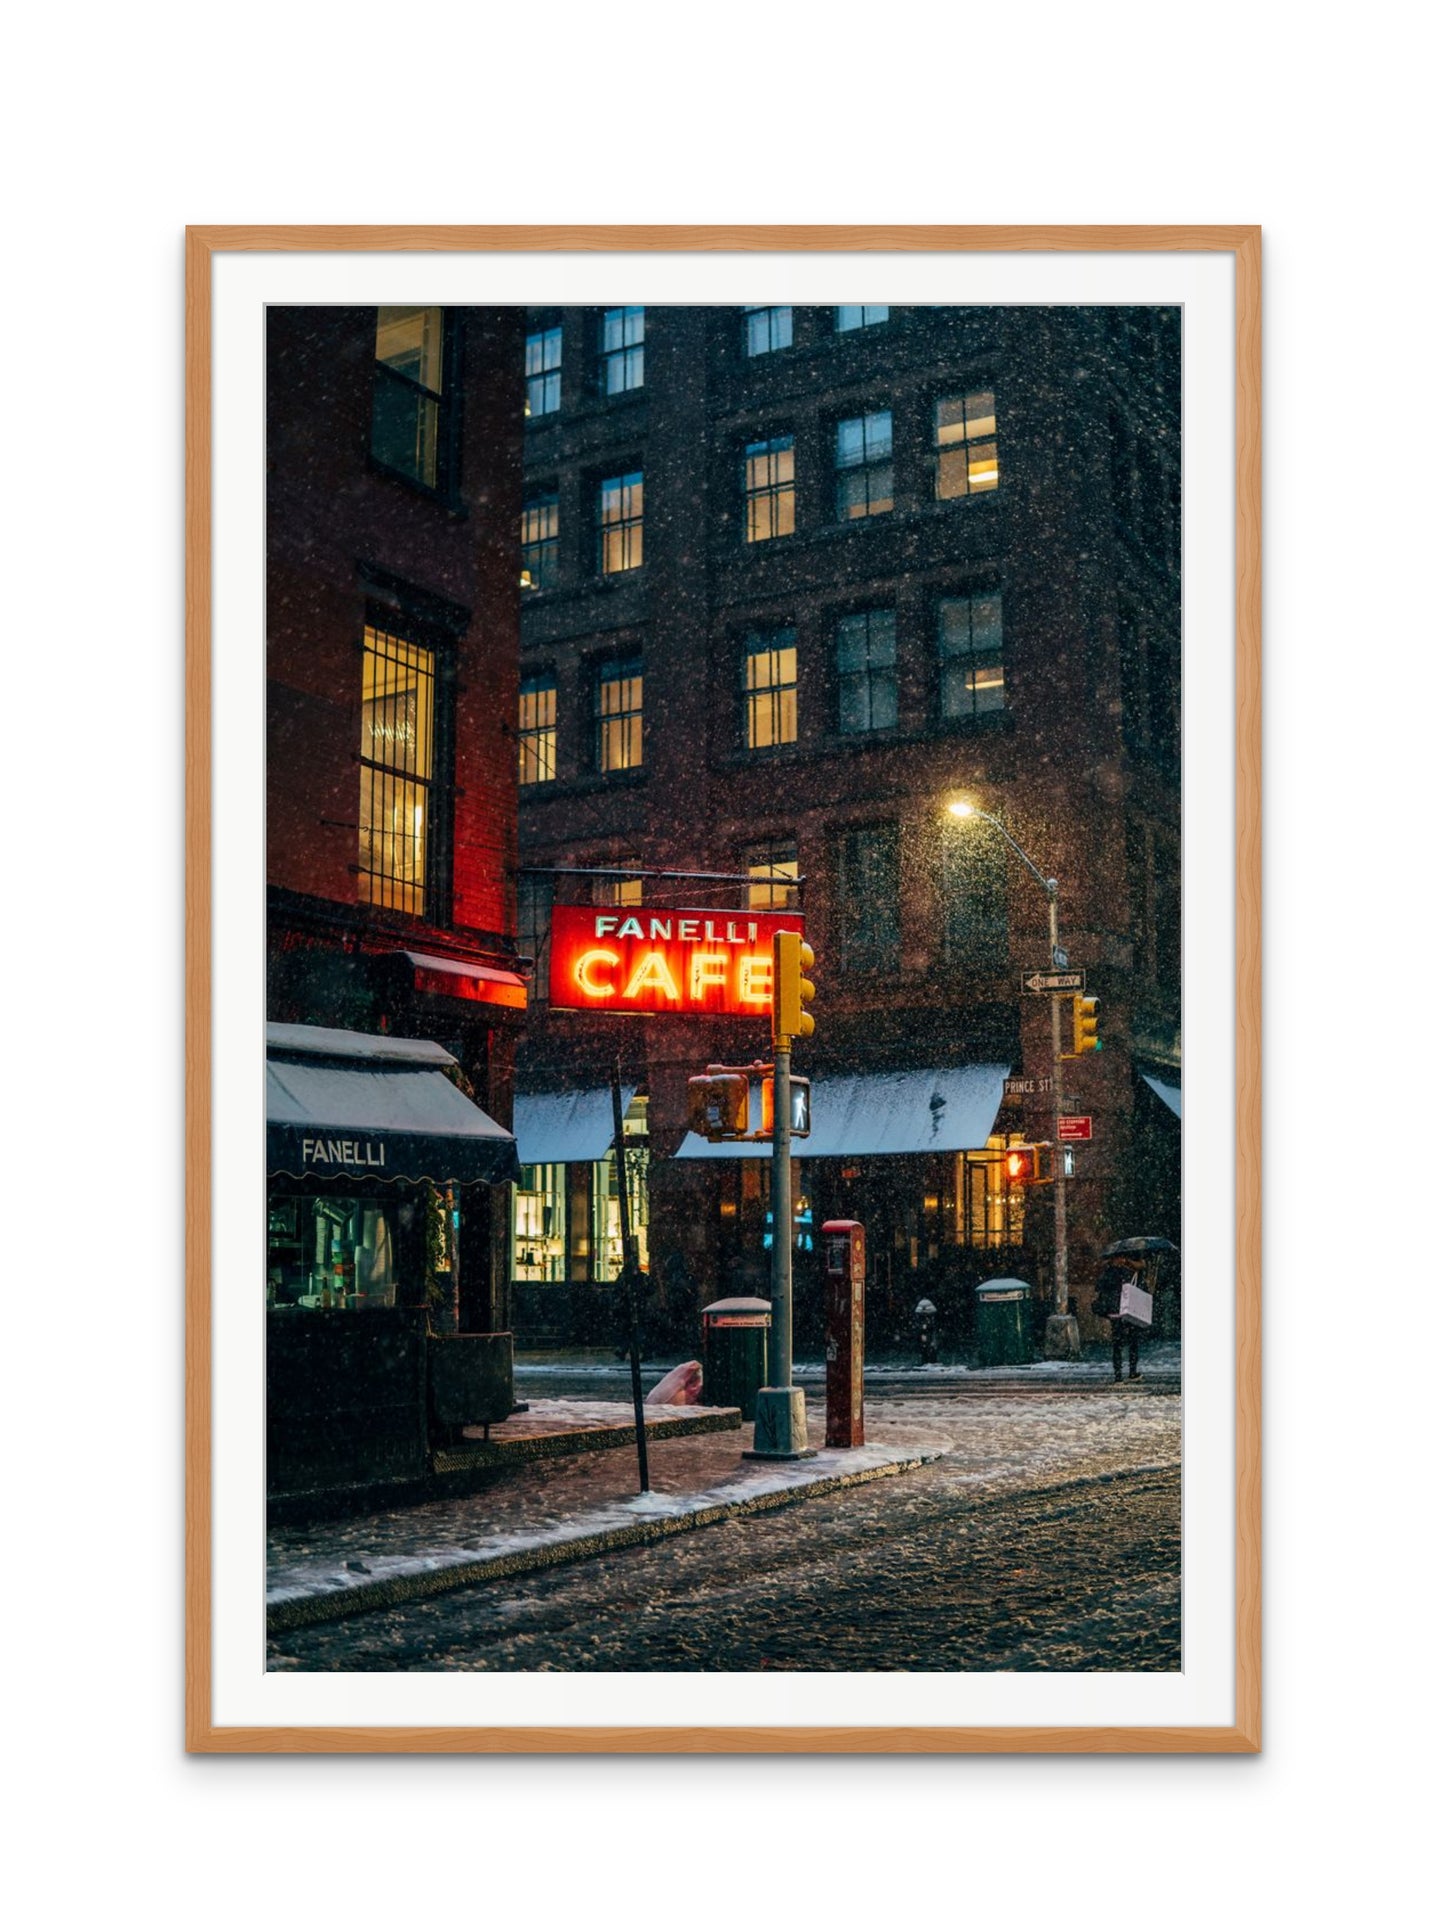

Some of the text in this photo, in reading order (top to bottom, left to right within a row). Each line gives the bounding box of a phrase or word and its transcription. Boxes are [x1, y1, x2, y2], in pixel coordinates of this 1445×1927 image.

[595, 915, 758, 944] FANELLI
[574, 949, 773, 1003] CAFE
[1031, 976, 1076, 988] ONE WAY
[1005, 1079, 1049, 1093] PRINCE ST
[303, 1138, 385, 1166] FANELLI
